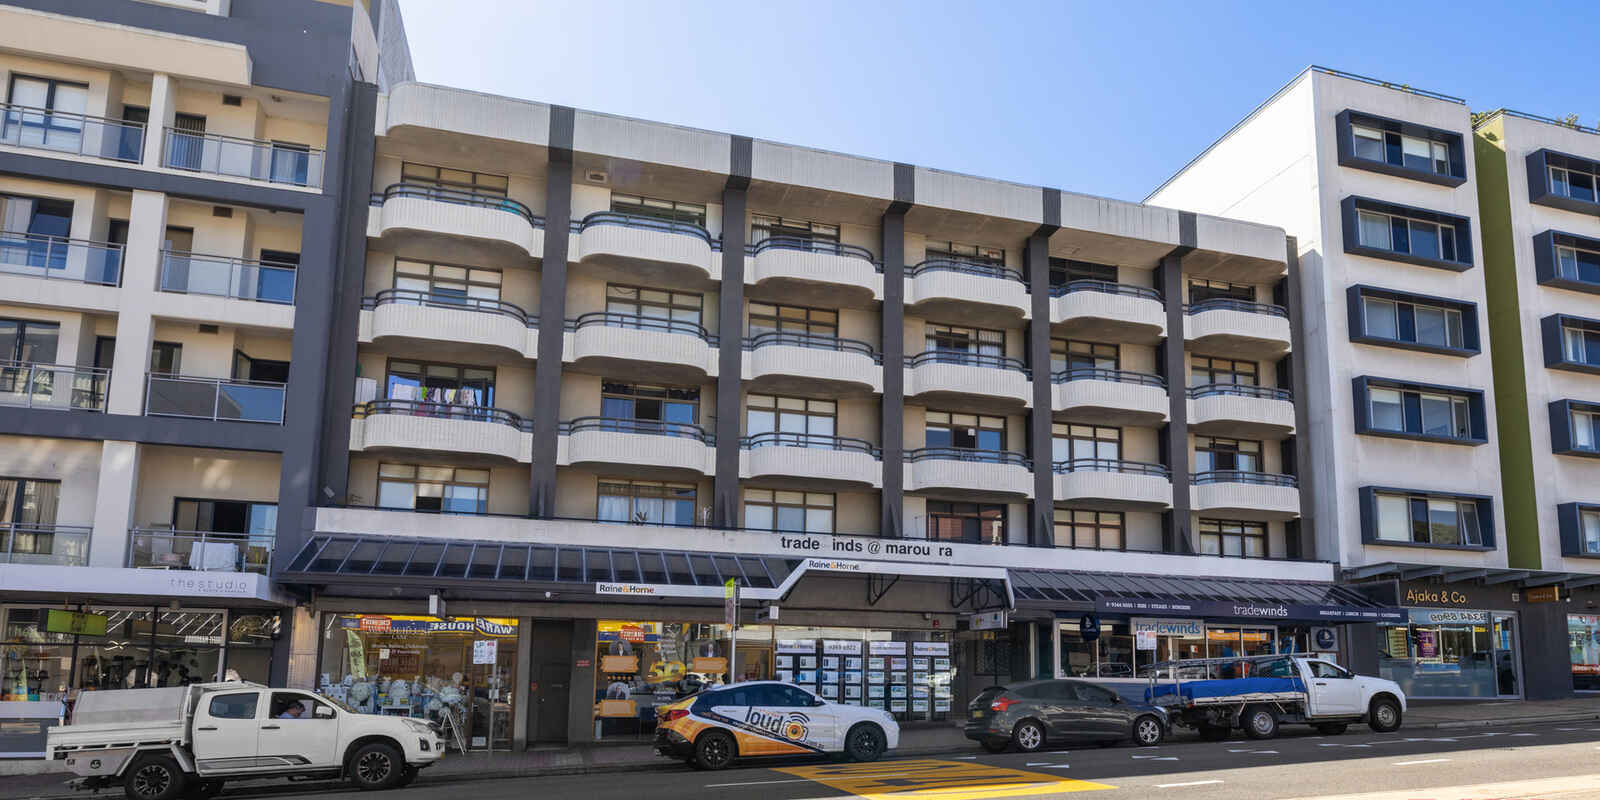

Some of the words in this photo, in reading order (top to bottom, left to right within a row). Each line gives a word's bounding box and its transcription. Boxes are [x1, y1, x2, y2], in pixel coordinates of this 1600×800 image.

[780, 536, 820, 550] trade
[832, 538, 863, 552] inds
[868, 541, 880, 555] @
[885, 542, 930, 556] marou
[808, 560, 860, 571] Raine&Horne
[198, 579, 247, 590] studio
[600, 584, 655, 594] Raine&Horne
[1407, 589, 1438, 604] Ajaka
[1441, 590, 1449, 603] &
[1451, 591, 1466, 604] Co
[1233, 604, 1288, 617] tradewinds
[745, 706, 784, 733] loud
